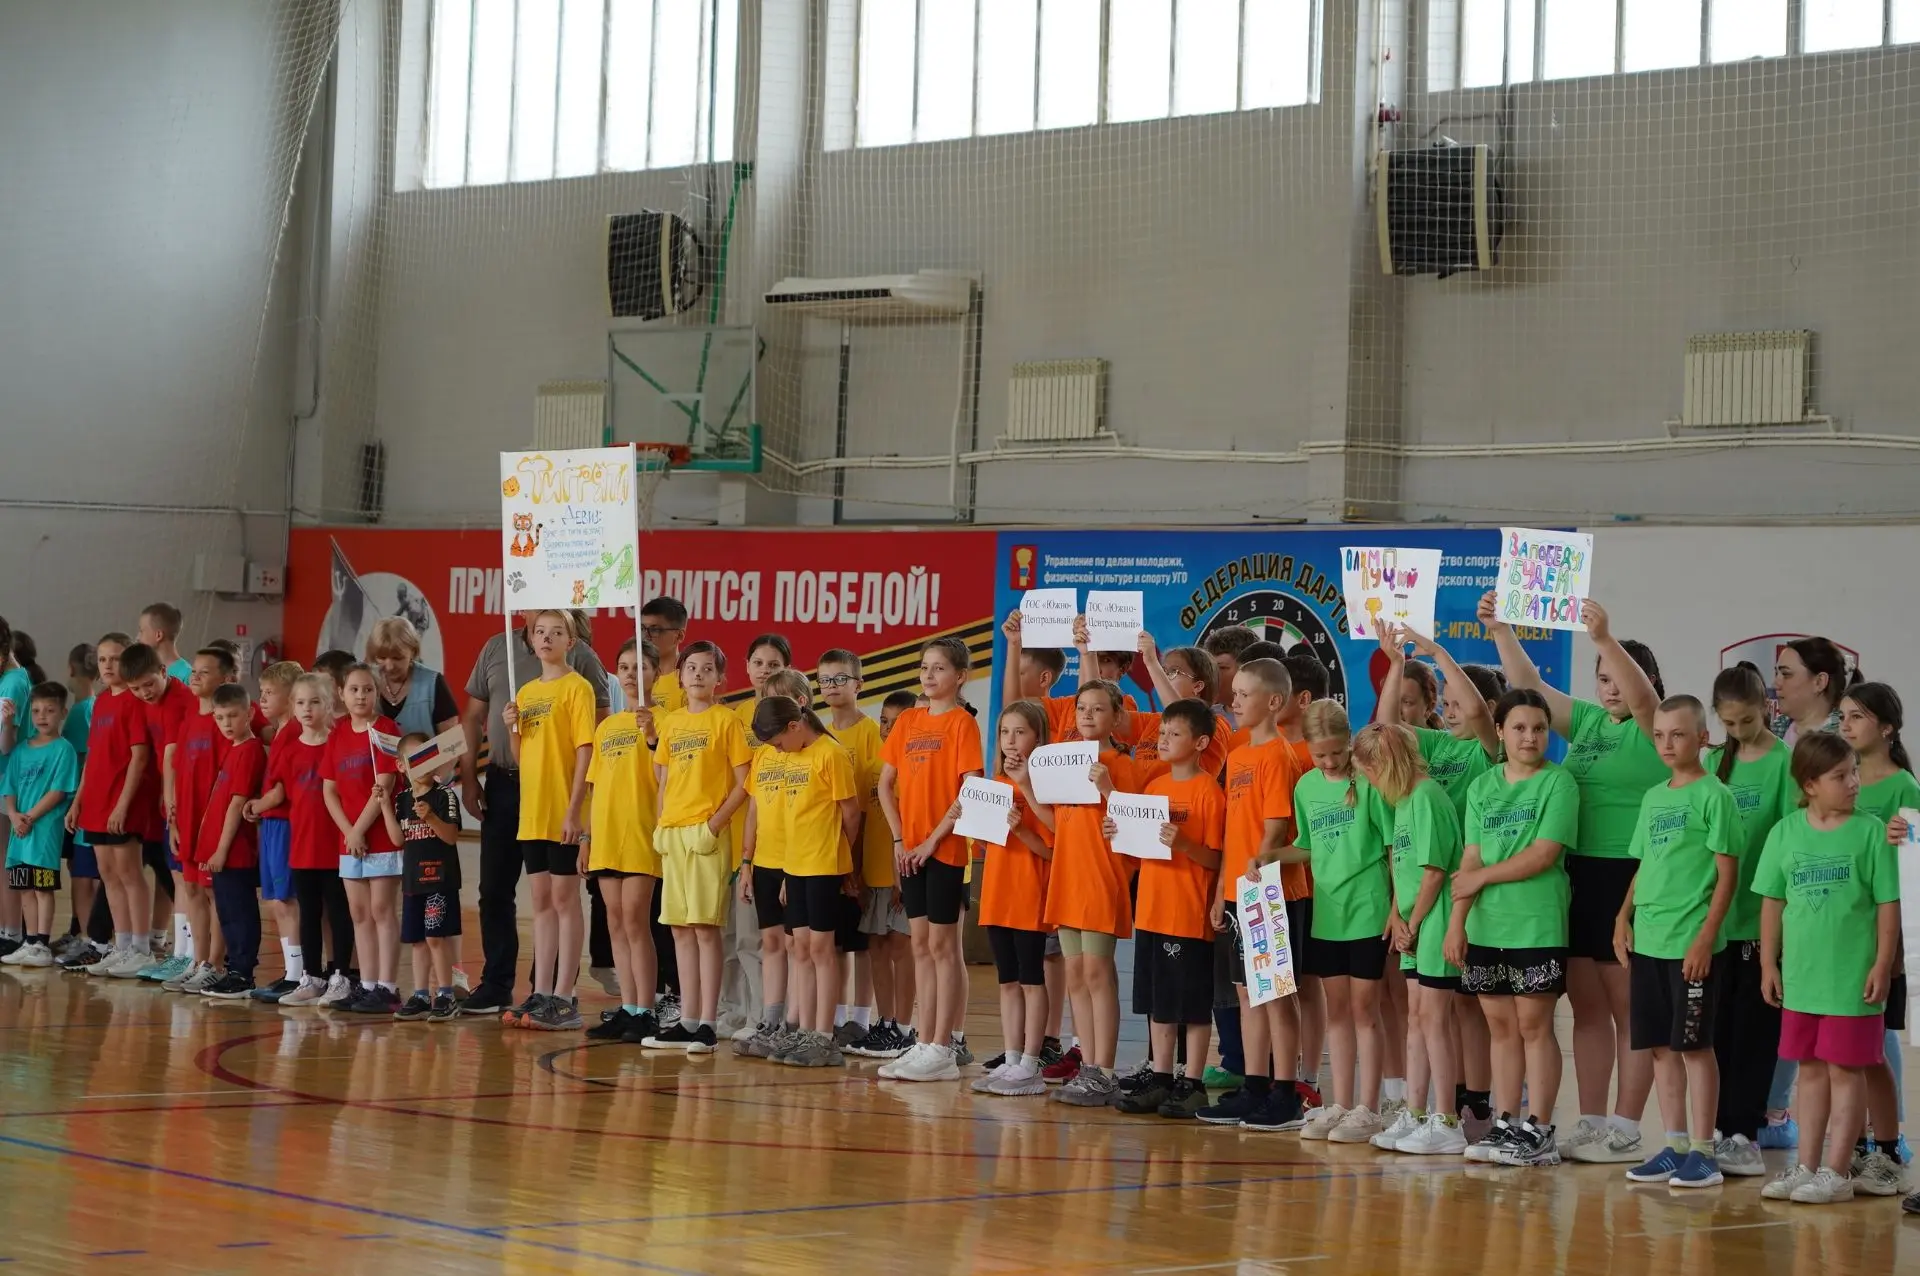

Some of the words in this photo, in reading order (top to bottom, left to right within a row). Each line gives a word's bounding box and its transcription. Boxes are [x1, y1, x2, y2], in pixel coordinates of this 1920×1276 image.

[1044, 554, 1093, 568] Управление
[1095, 557, 1105, 566] по
[1106, 557, 1135, 567] делам
[1136, 557, 1185, 568] молодежи,
[1346, 548, 1398, 571] ОЛИМП
[1044, 571, 1093, 584] физической
[1095, 573, 1133, 585] культуре
[1134, 574, 1140, 583] и
[1141, 573, 1172, 585] спорту
[1172, 571, 1188, 584] УГО
[1510, 559, 1570, 595] БУДЕМ
[1180, 552, 1295, 631] ФЕДЕРАЦИЯ
[608, 569, 761, 622] РДИТСЯ
[774, 566, 940, 633] ПОБЕДОЙ!
[1025, 600, 1040, 610] ТОС
[1250, 600, 1257, 611] 5
[1273, 599, 1285, 611] 20
[1088, 602, 1103, 613] ТОС
[1227, 610, 1238, 621] 12
[1297, 610, 1302, 622] 1
[1314, 632, 1325, 643] 18
[1329, 660, 1335, 670] 4
[1031, 753, 1094, 768] СОКОЛЯТА
[961, 787, 1012, 809] СОКОЛЯТА
[1108, 803, 1166, 820] СОКОЛЯТА
[1264, 884, 1289, 966] ОЛИМП
